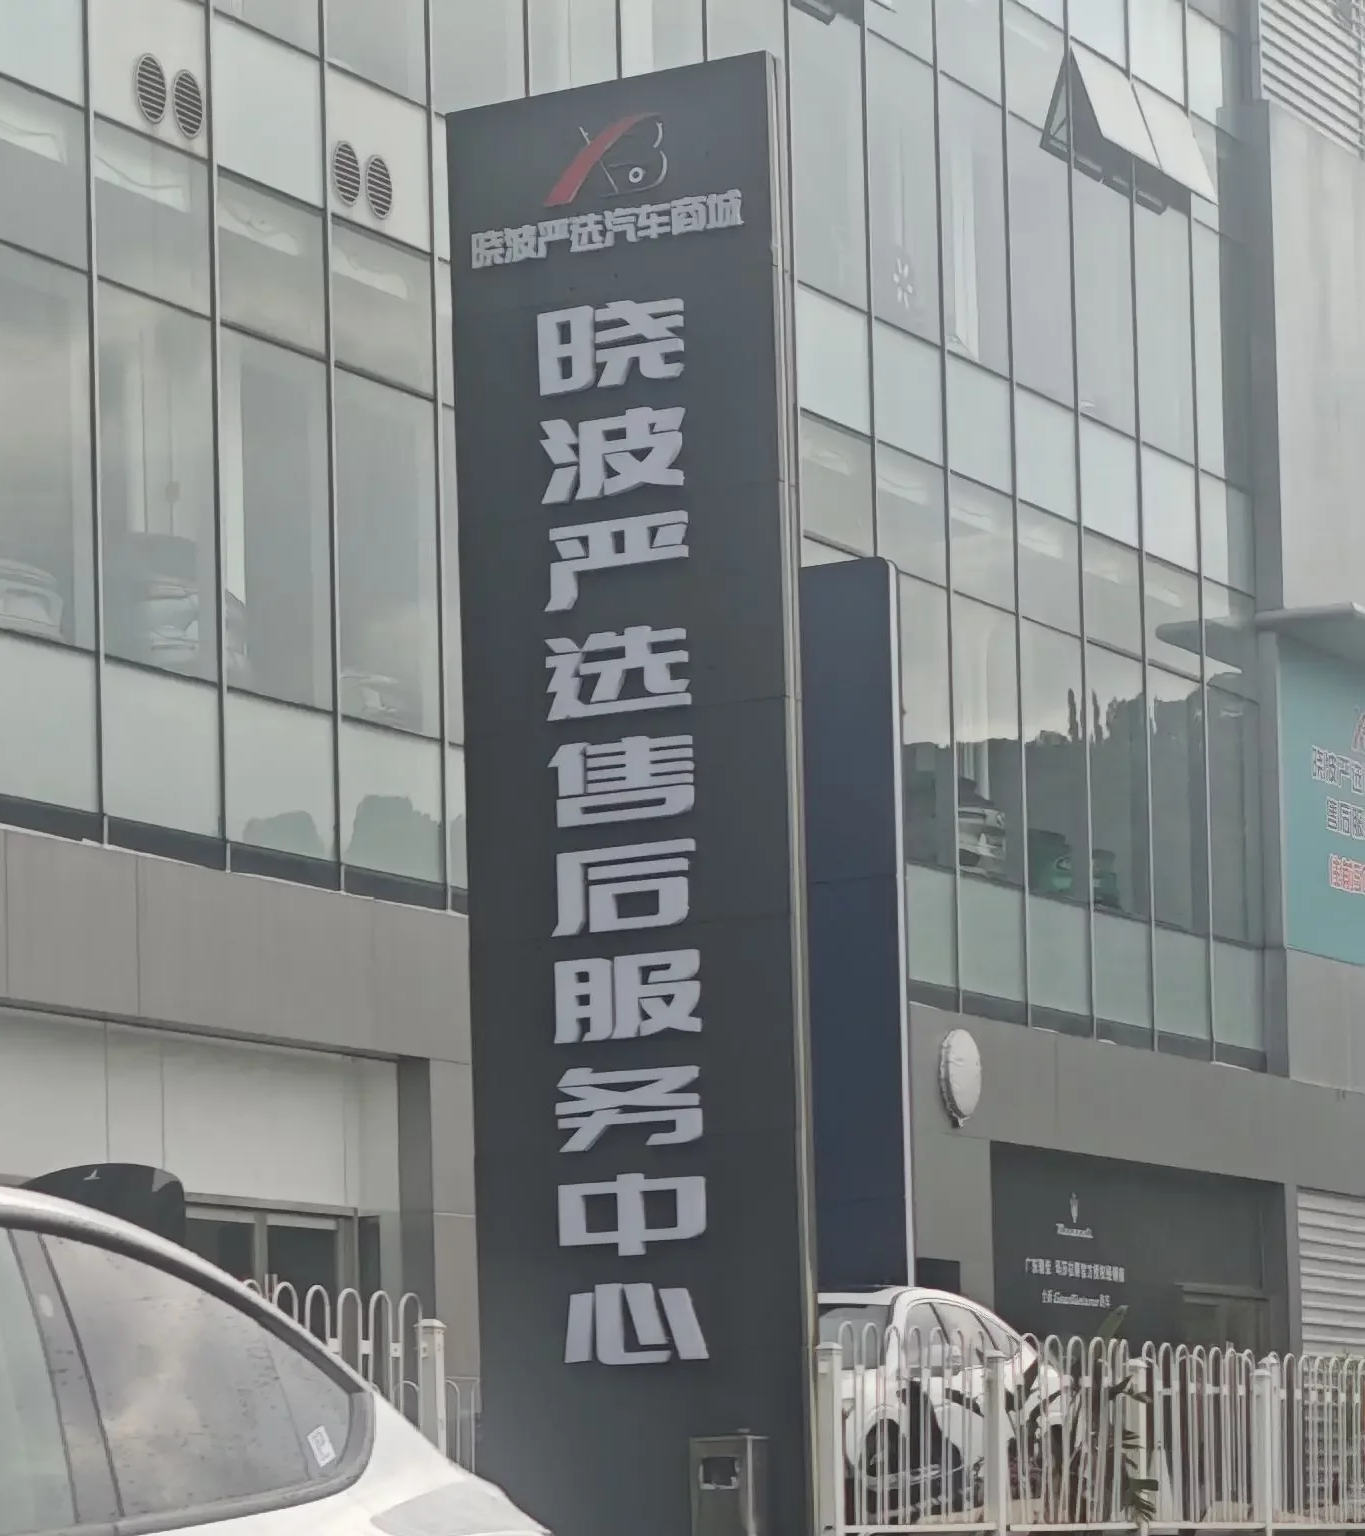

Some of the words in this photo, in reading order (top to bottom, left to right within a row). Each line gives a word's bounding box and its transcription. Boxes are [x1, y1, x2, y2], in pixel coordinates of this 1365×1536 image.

[471, 188, 745, 269] 晓波严选汽车商城
[537, 297, 709, 1366] 晓波严选售后服务中心
